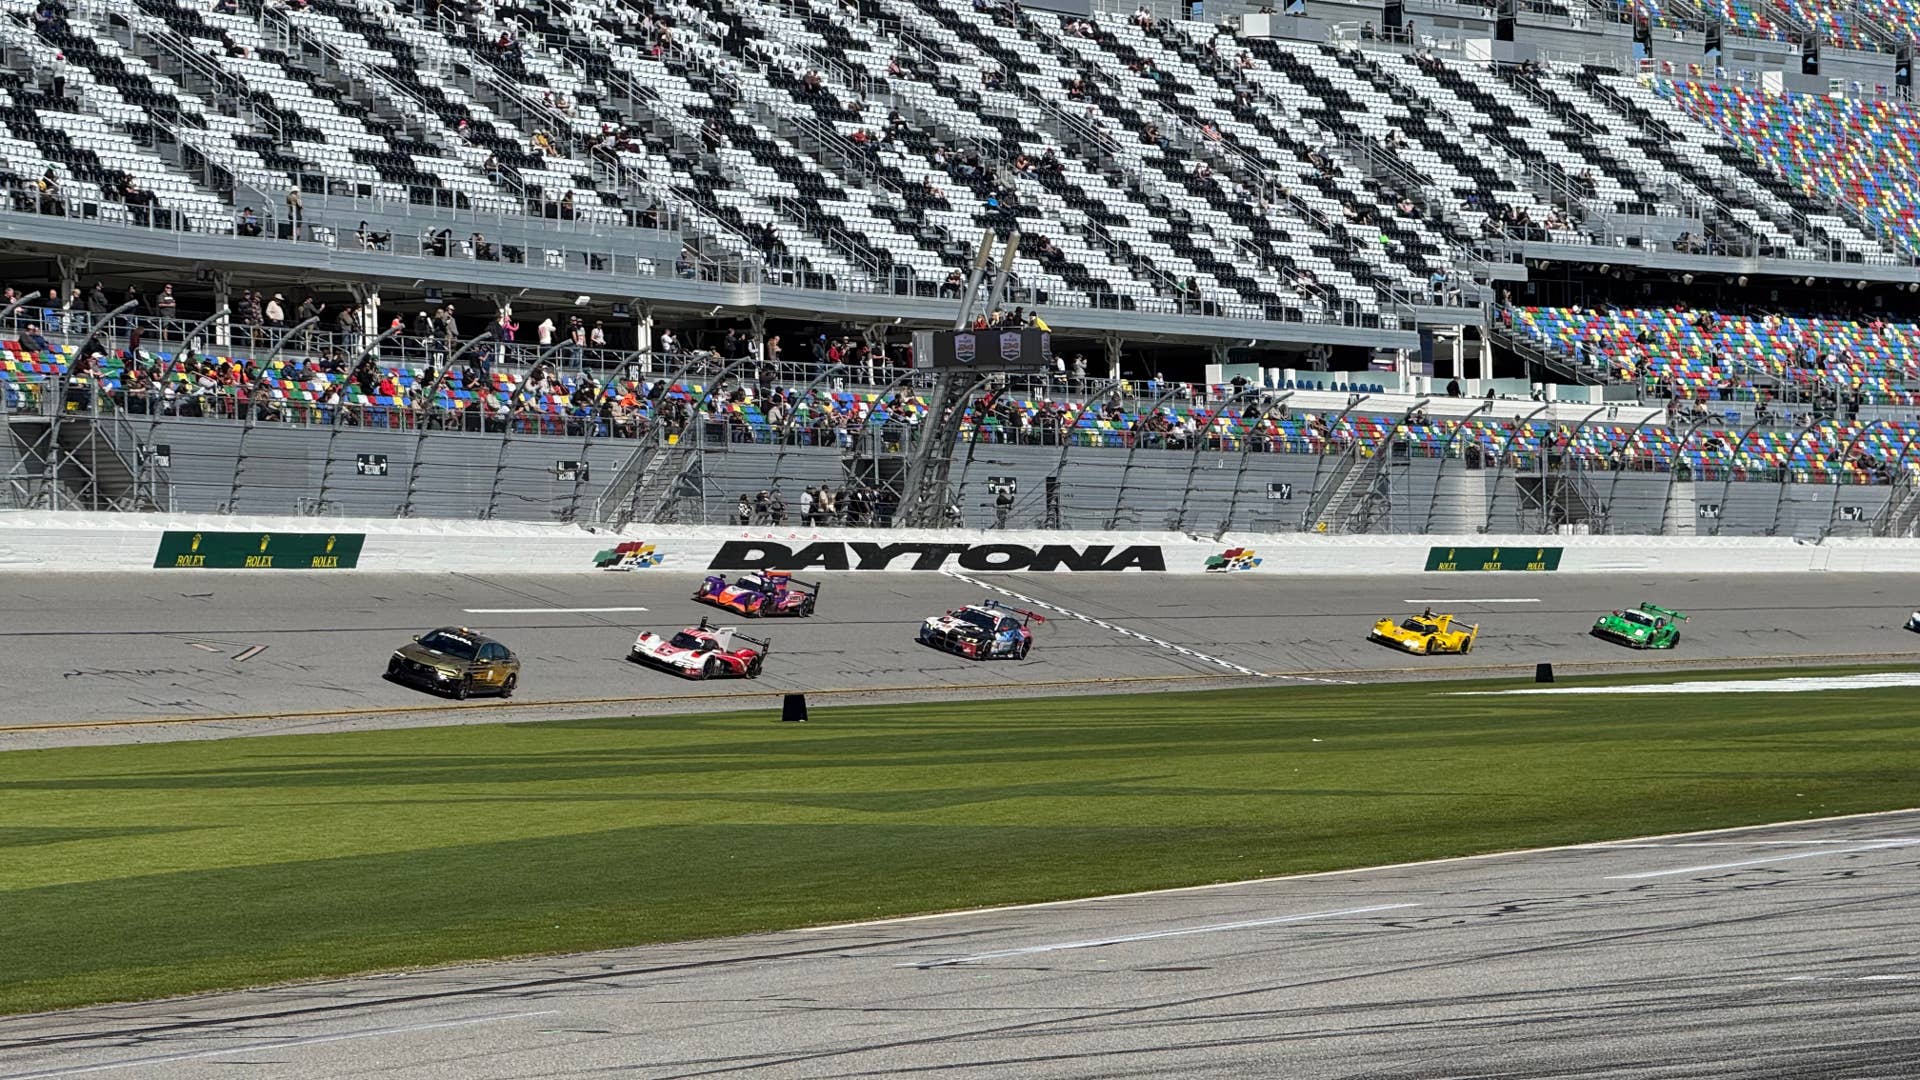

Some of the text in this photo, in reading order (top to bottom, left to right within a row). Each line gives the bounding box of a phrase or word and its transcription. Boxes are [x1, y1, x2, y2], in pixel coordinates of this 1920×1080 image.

[433, 352, 444, 369] 147
[833, 377, 843, 392] 145
[175, 555, 206, 567] ROLEX
[245, 555, 274, 567] ROLEX
[312, 555, 339, 567] ROLEX
[707, 540, 1167, 571] DAYTONA
